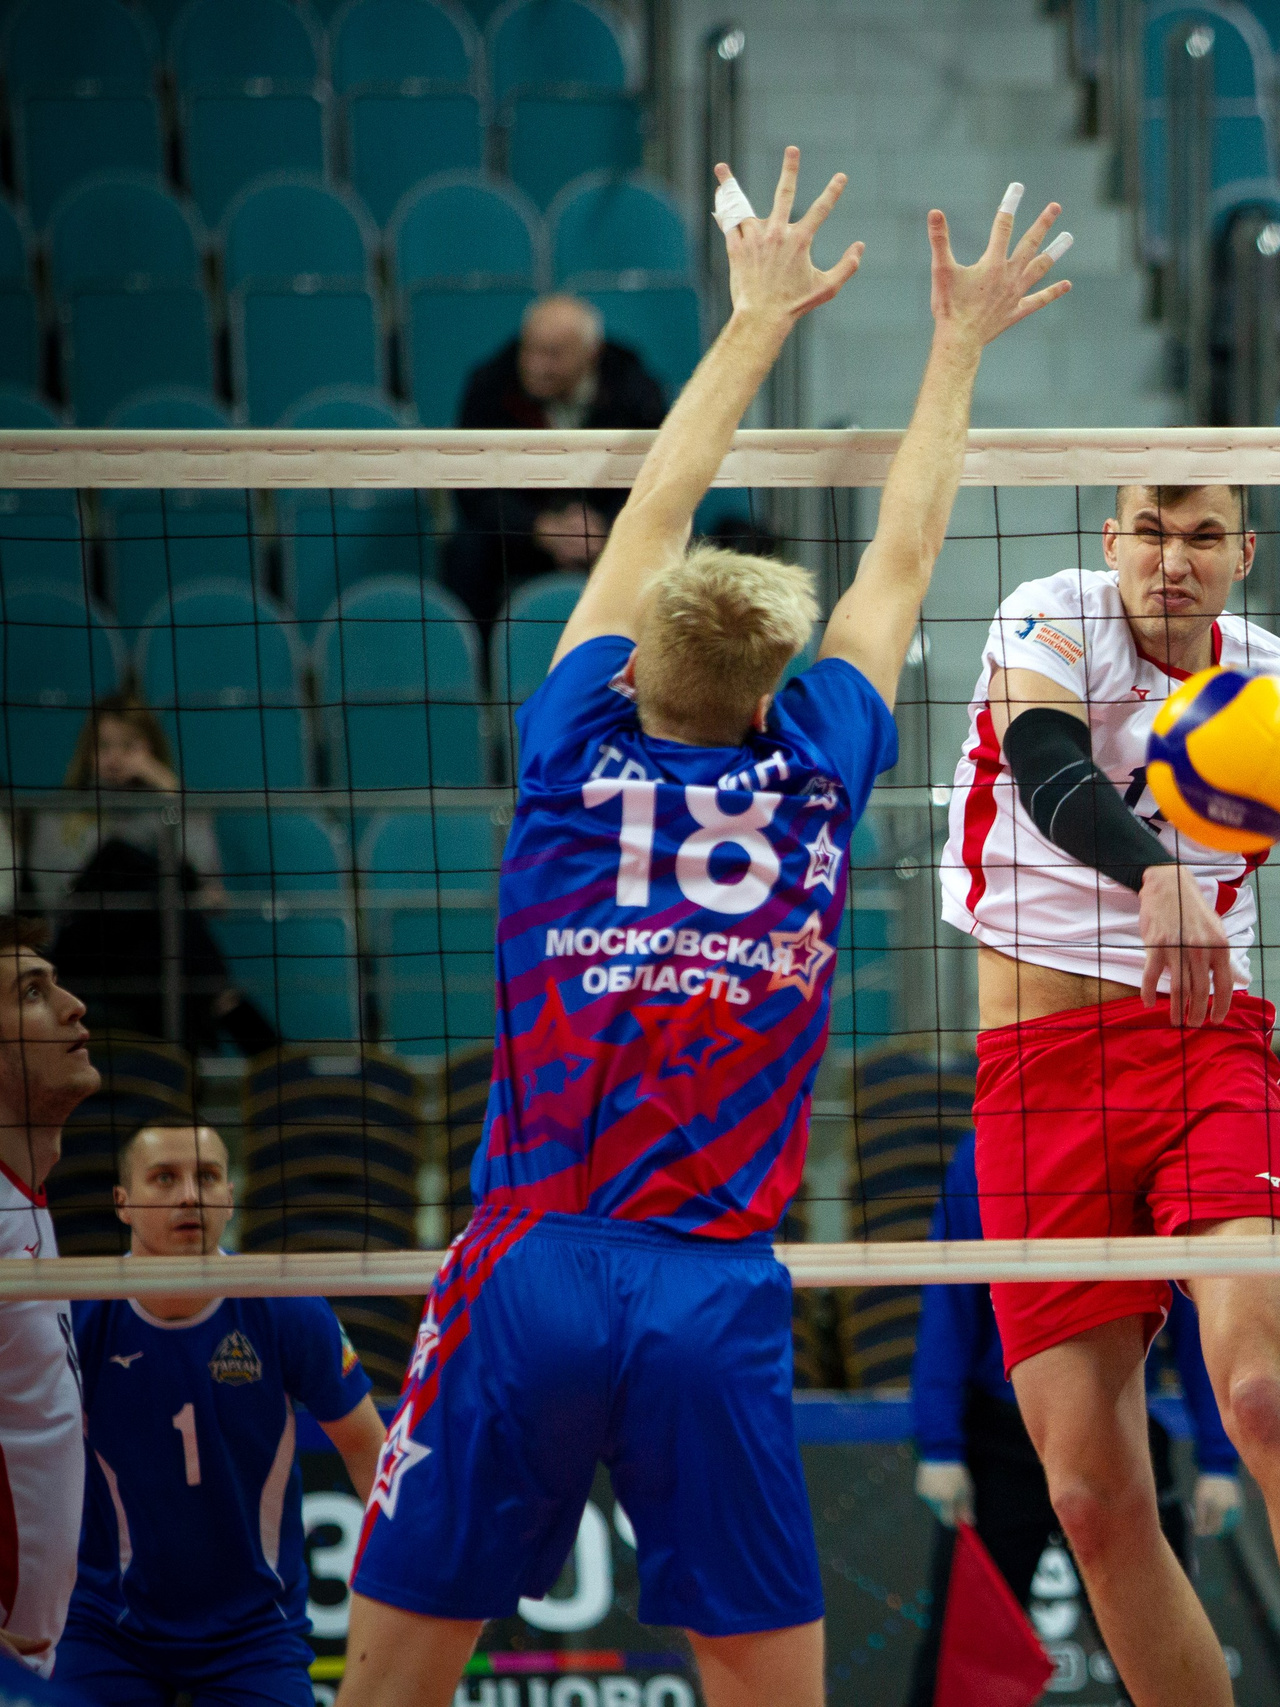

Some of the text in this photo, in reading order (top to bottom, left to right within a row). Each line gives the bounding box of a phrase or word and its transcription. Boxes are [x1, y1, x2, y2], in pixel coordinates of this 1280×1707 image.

[1041, 626, 1084, 658] ФЕДЕРАЦИЯ
[582, 778, 783, 914] 18
[545, 928, 793, 976] МОСКОВСКАЯ
[582, 964, 752, 1005] ОБЛАСТЬ
[171, 1402, 201, 1486] 1
